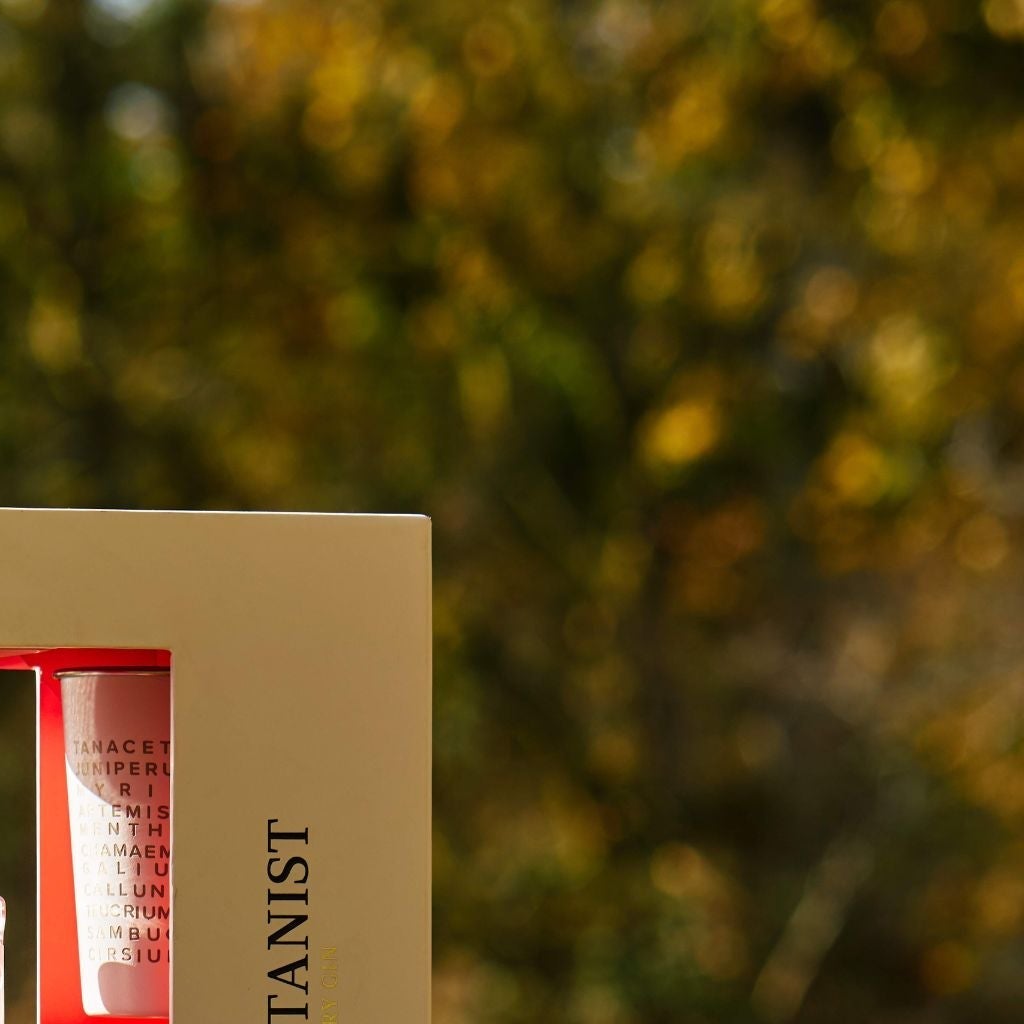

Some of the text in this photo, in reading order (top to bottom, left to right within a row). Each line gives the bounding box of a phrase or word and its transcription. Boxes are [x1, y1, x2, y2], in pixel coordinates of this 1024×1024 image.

[87, 926, 170, 941] SAMBU
[89, 947, 170, 963] CIRSIU
[319, 945, 338, 990] GIN
